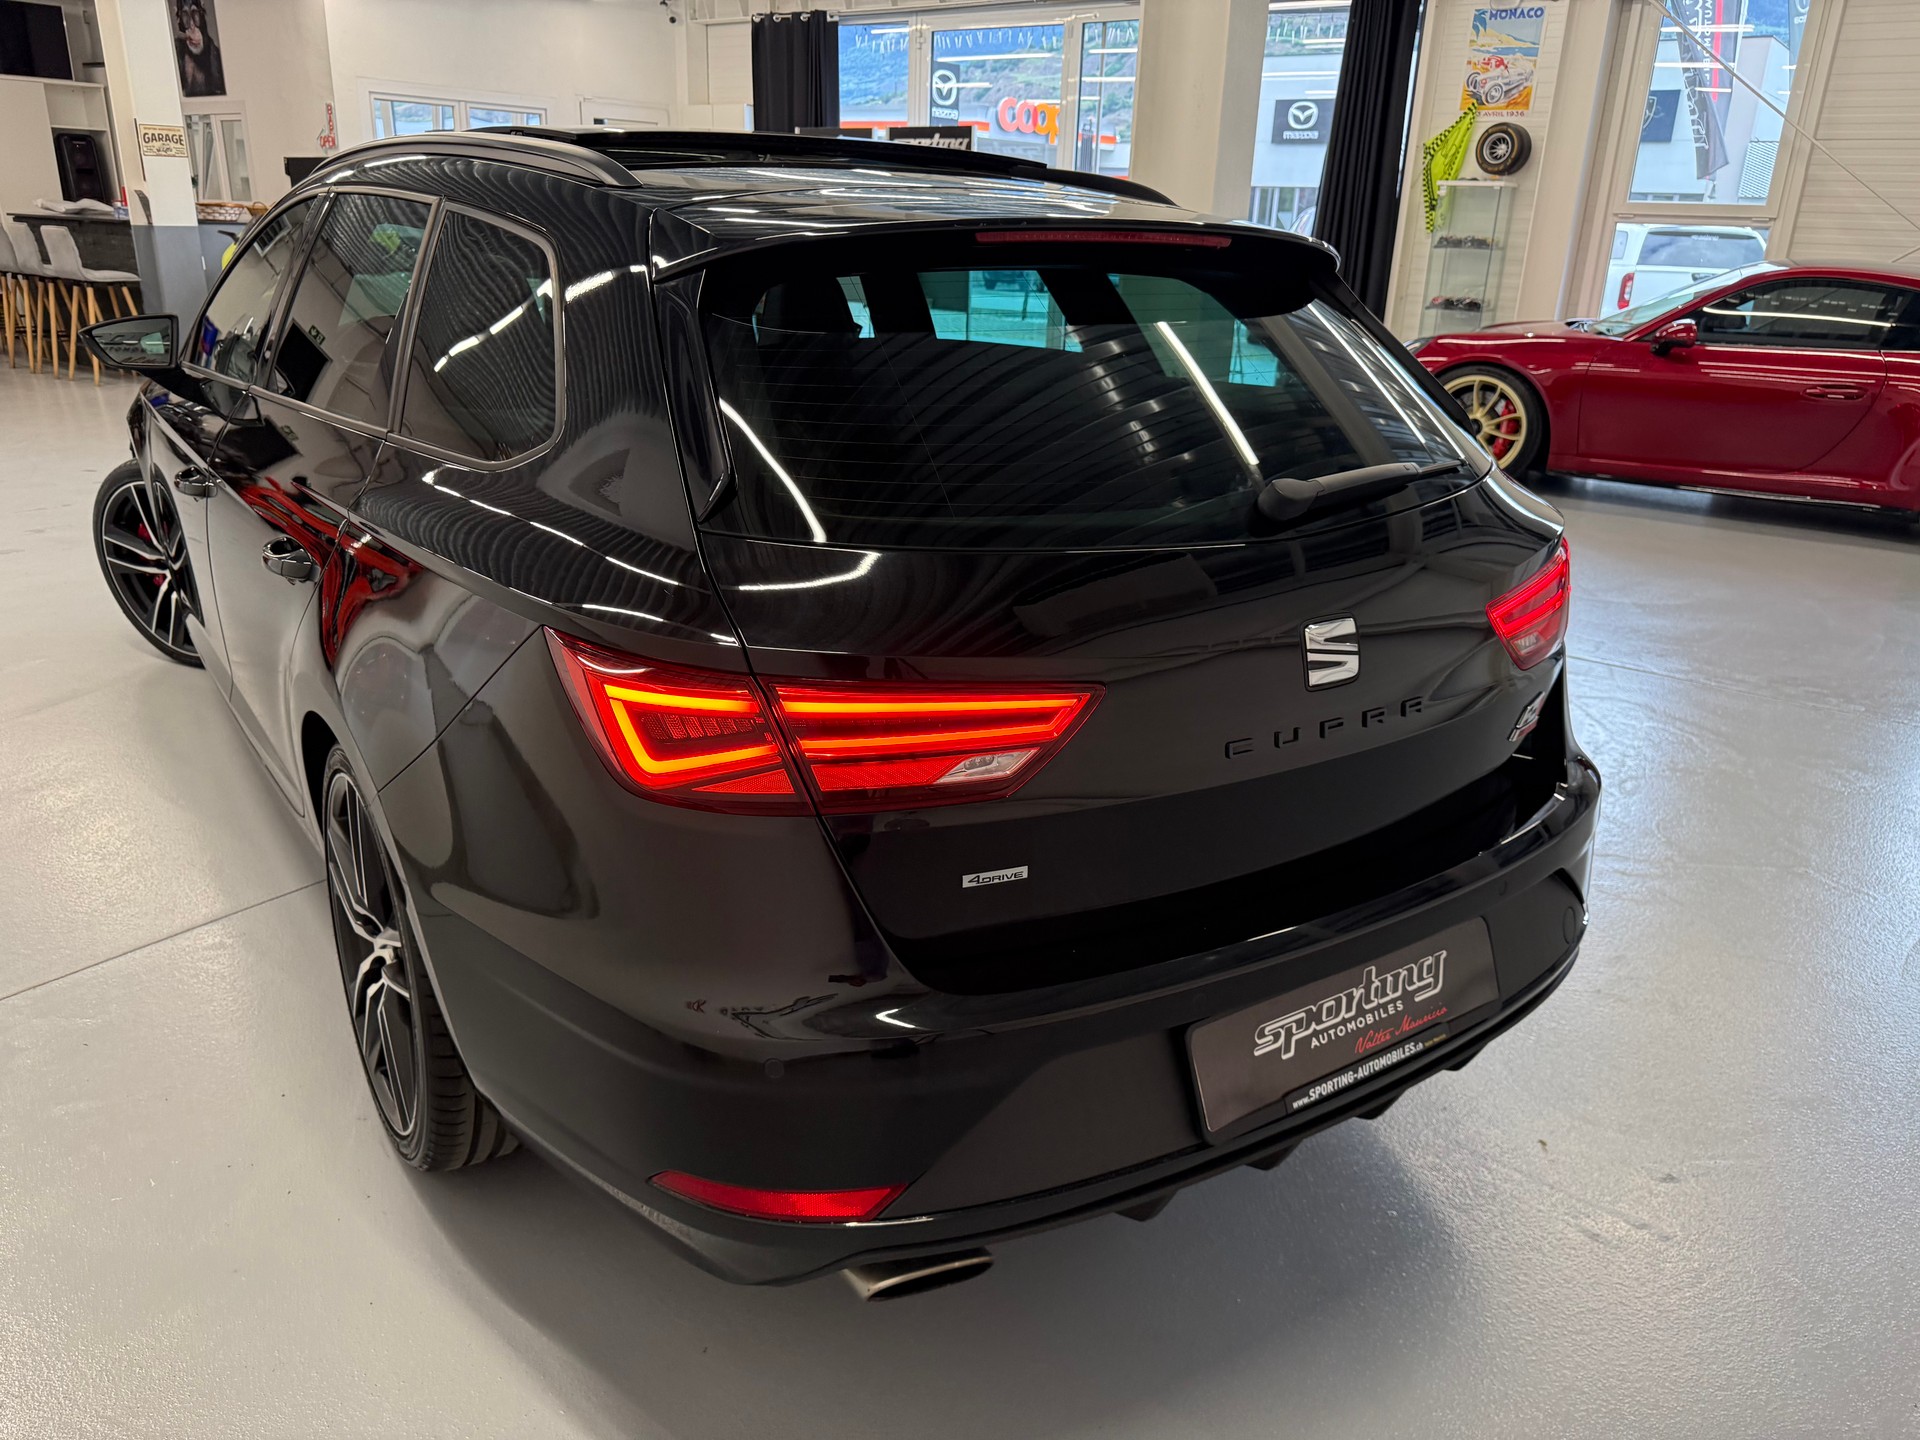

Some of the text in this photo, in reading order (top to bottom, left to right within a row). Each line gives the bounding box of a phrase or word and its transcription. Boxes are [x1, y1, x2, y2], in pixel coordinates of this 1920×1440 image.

[1489, 6, 1545, 20] MONACO
[142, 132, 185, 147] GARAGE
[1283, 130, 1319, 140] mazda
[967, 870, 1024, 885] 4DRIVE
[1253, 949, 1447, 1060] sporting
[1310, 1000, 1404, 1049] AUTOMOBILES
[1292, 1041, 1424, 1110] www.SPORTING-AUTOMOBILES.ch
